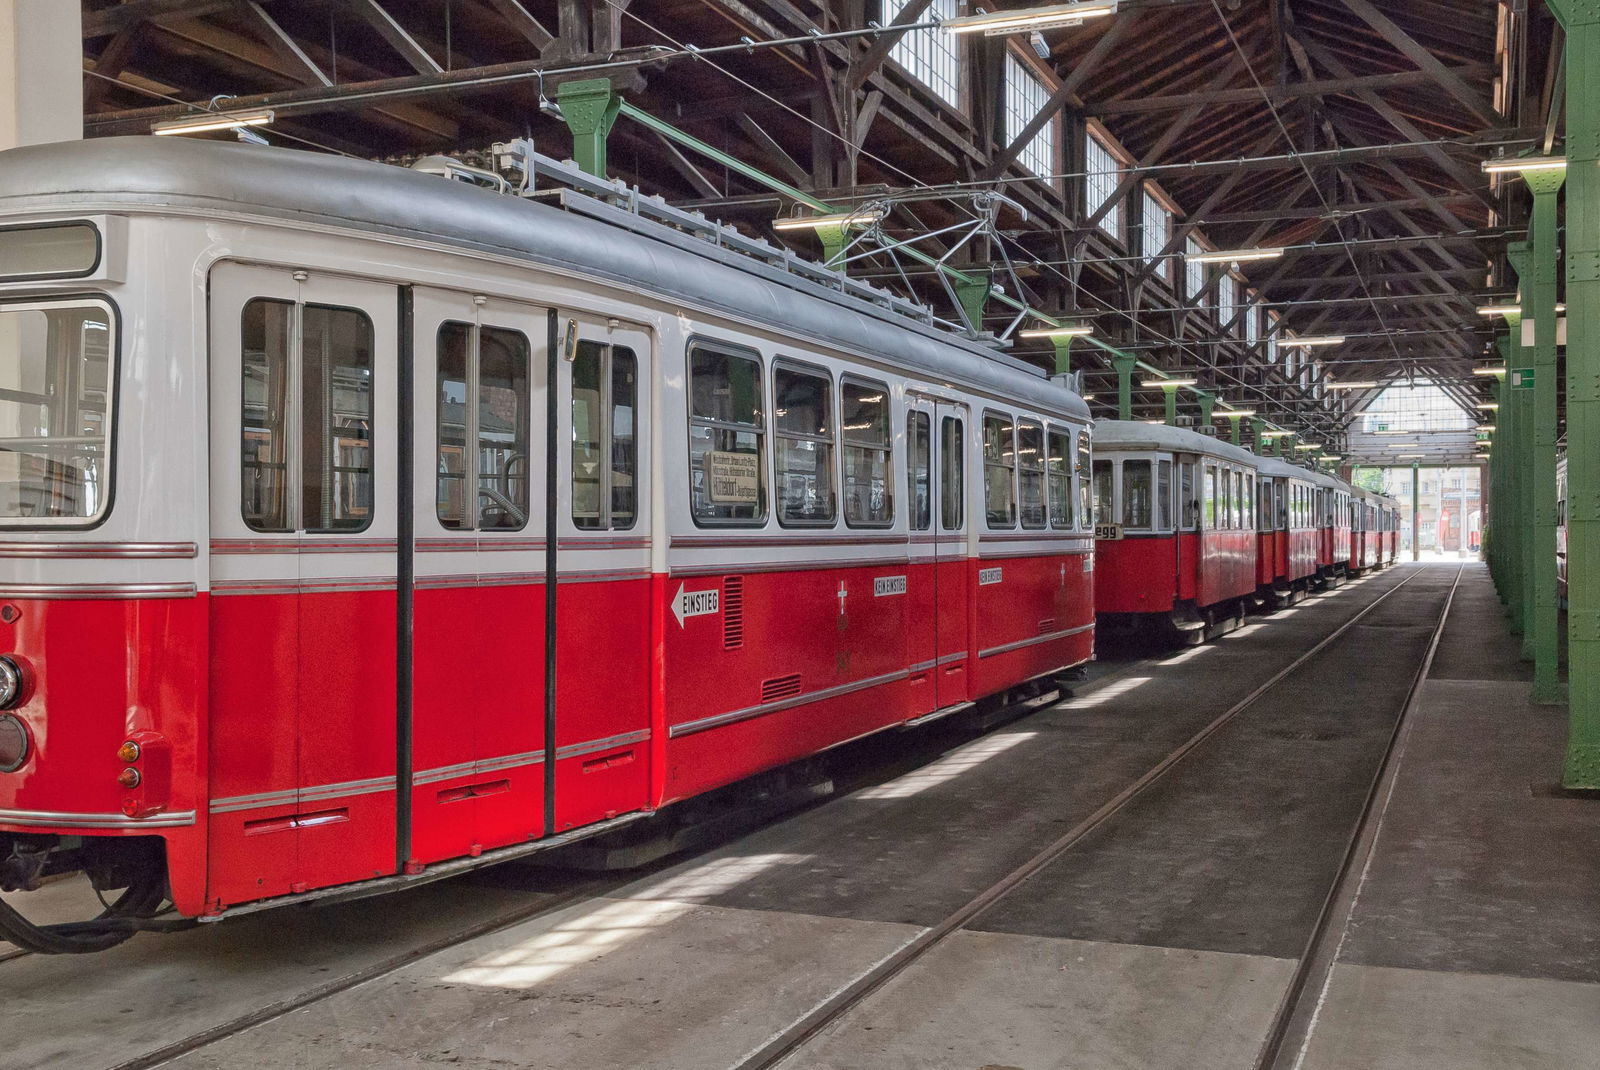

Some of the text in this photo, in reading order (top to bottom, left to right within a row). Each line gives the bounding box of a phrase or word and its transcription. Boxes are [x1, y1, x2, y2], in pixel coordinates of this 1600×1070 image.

[875, 577, 905, 595] KEIN EINSTIEG
[683, 592, 718, 614] EINSTIEG
